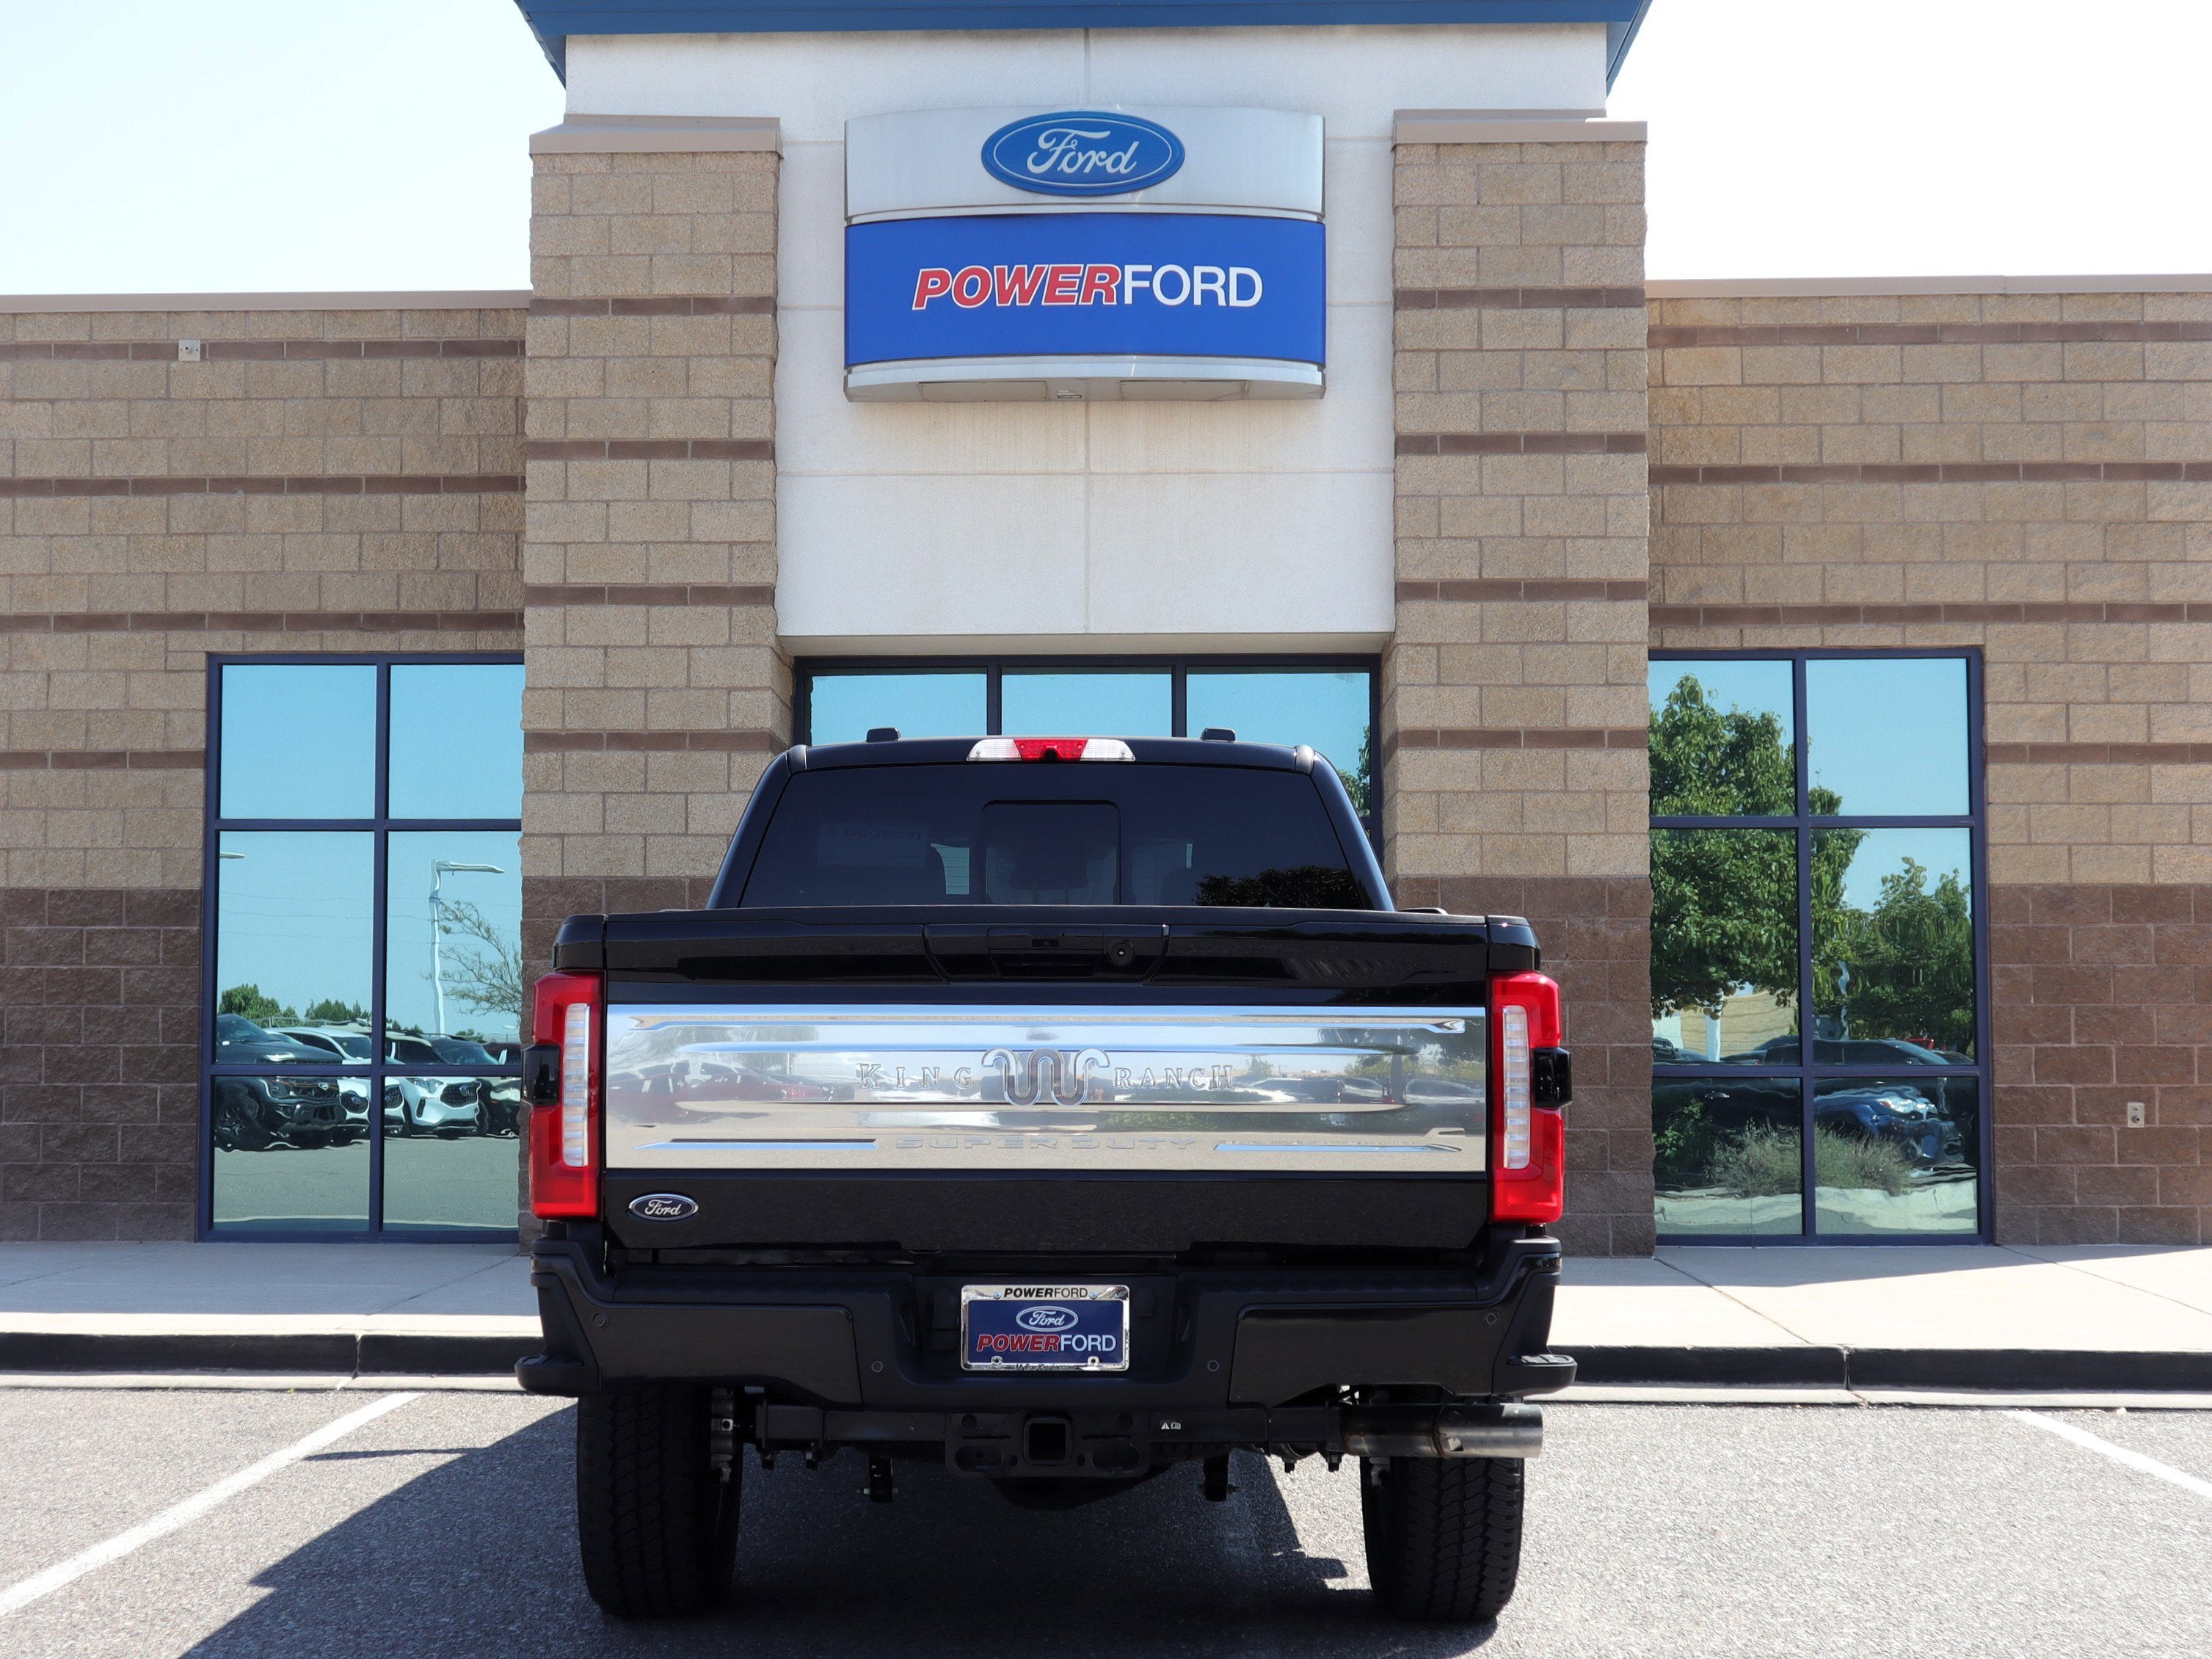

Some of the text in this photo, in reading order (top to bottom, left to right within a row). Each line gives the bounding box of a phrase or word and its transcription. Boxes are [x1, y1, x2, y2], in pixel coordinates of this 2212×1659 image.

[1026, 127, 1140, 174] Ford
[912, 264, 1263, 310] POWERFORD
[857, 1062, 1235, 1091] KING RANCH
[895, 1136, 1198, 1150] SUPER DUTY
[644, 1199, 682, 1215] Ford
[1003, 1288, 1088, 1298] POWERFORD
[1029, 1310, 1066, 1326] Ford
[976, 1334, 1117, 1351] POWERFORD
